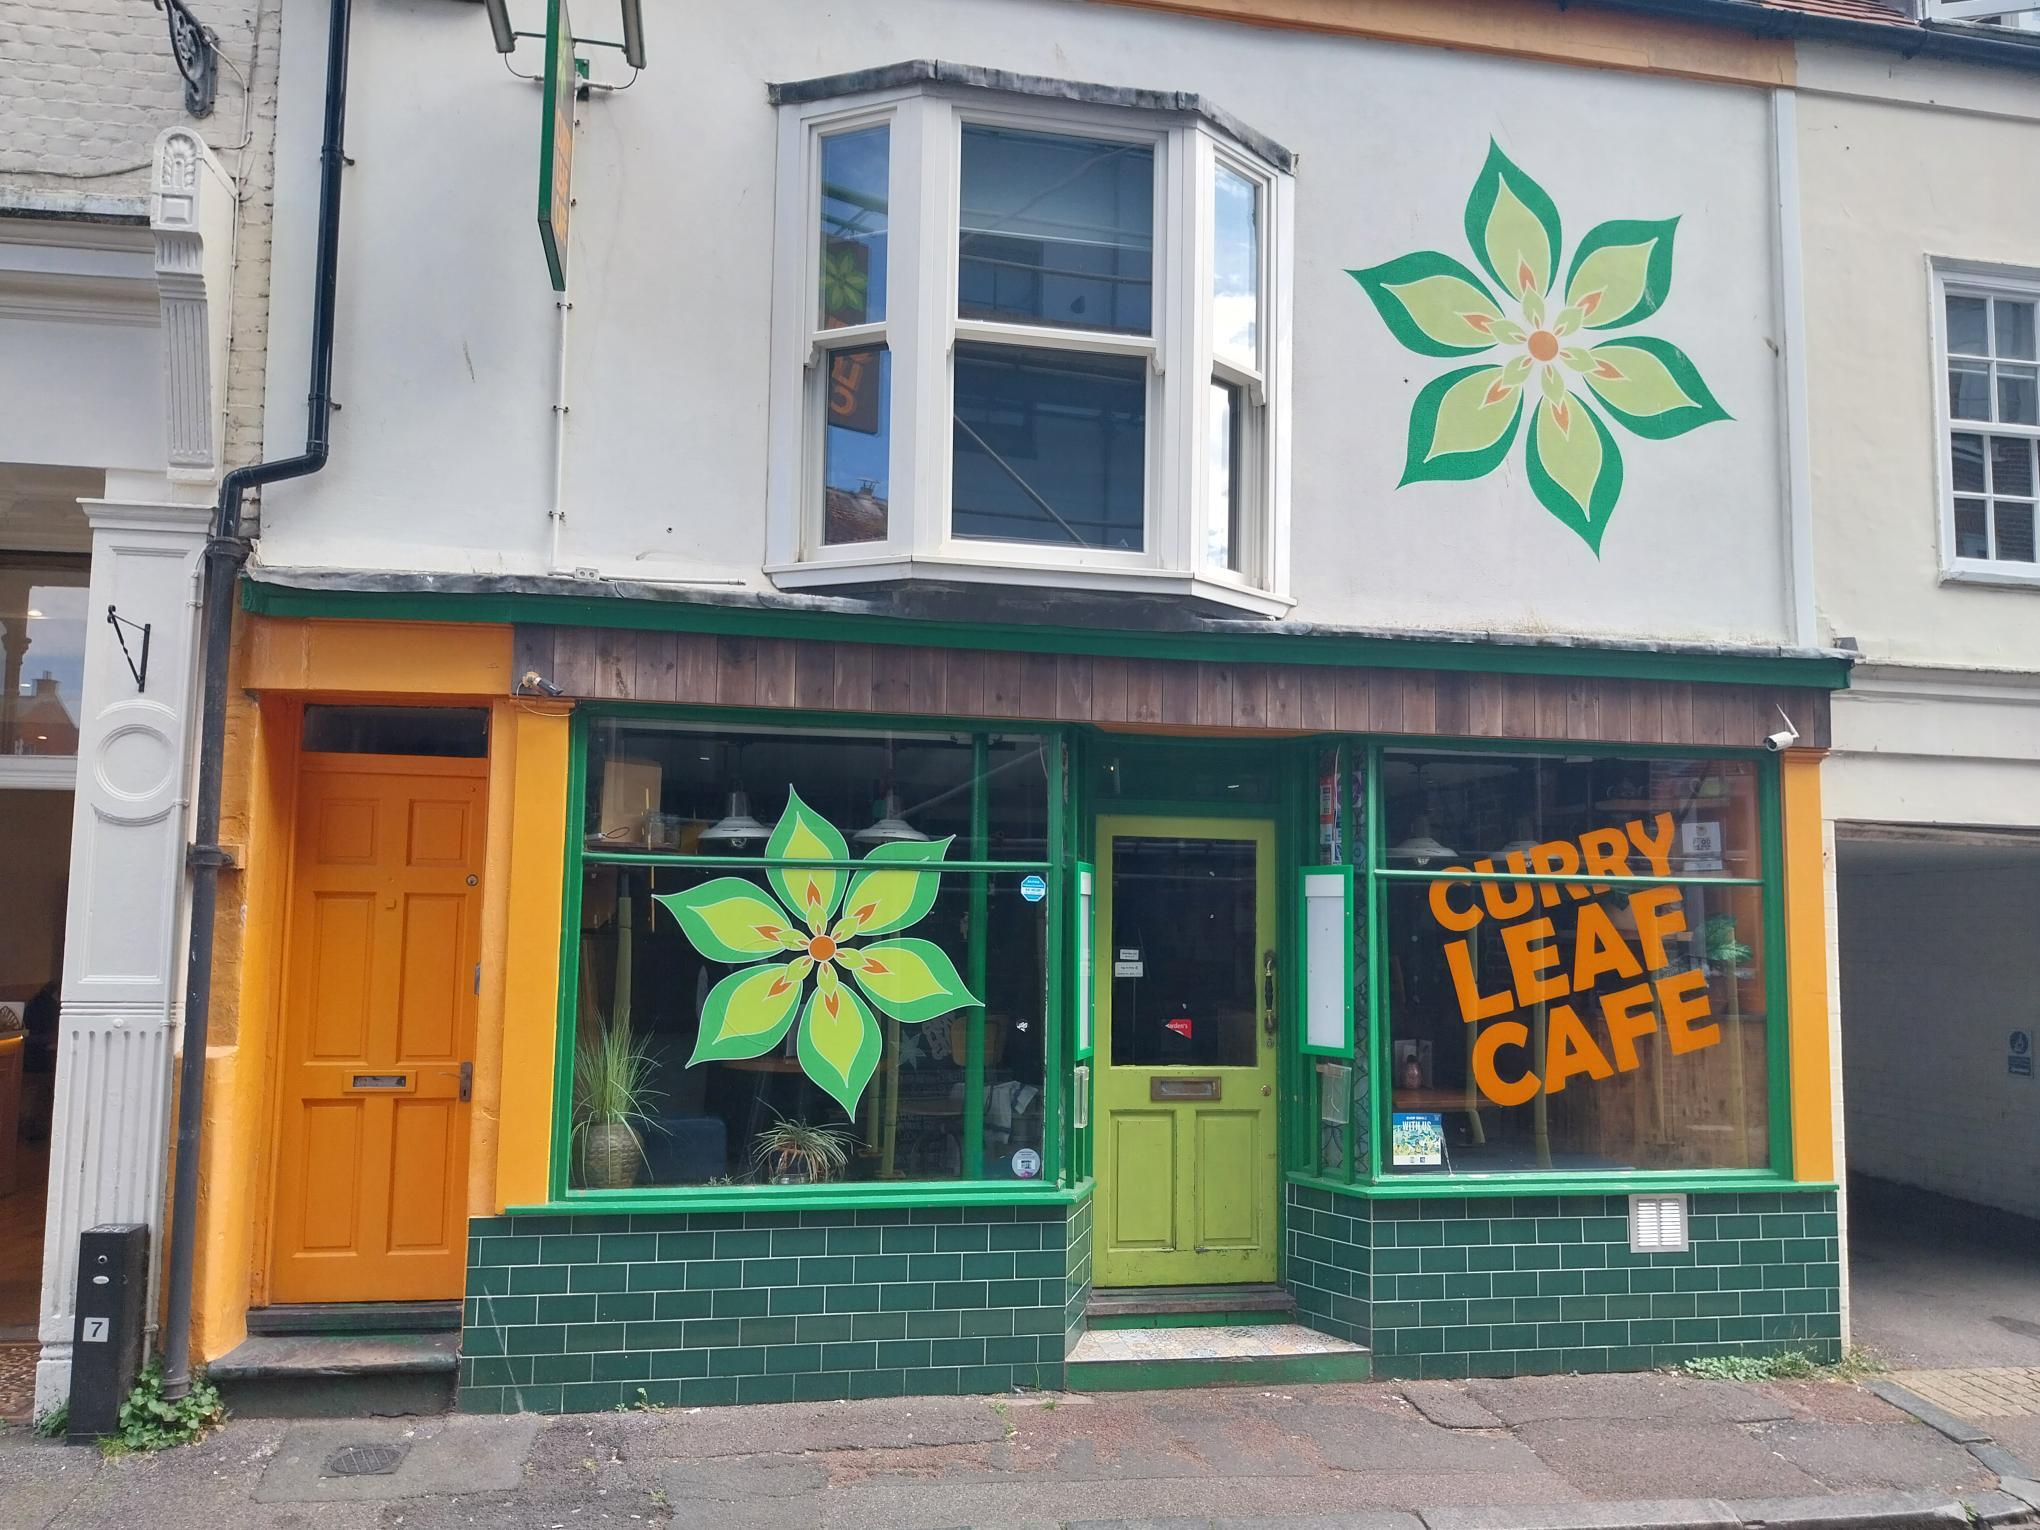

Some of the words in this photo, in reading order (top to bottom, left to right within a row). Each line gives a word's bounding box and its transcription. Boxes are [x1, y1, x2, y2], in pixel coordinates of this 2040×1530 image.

[1428, 811, 1676, 932] CURRY
[1443, 884, 1688, 1024] LEAF
[1471, 967, 1721, 1106] CAFE
[1402, 1120, 1420, 1131] WITH
[1423, 1120, 1432, 1130] US
[90, 1321, 103, 1338] 7
